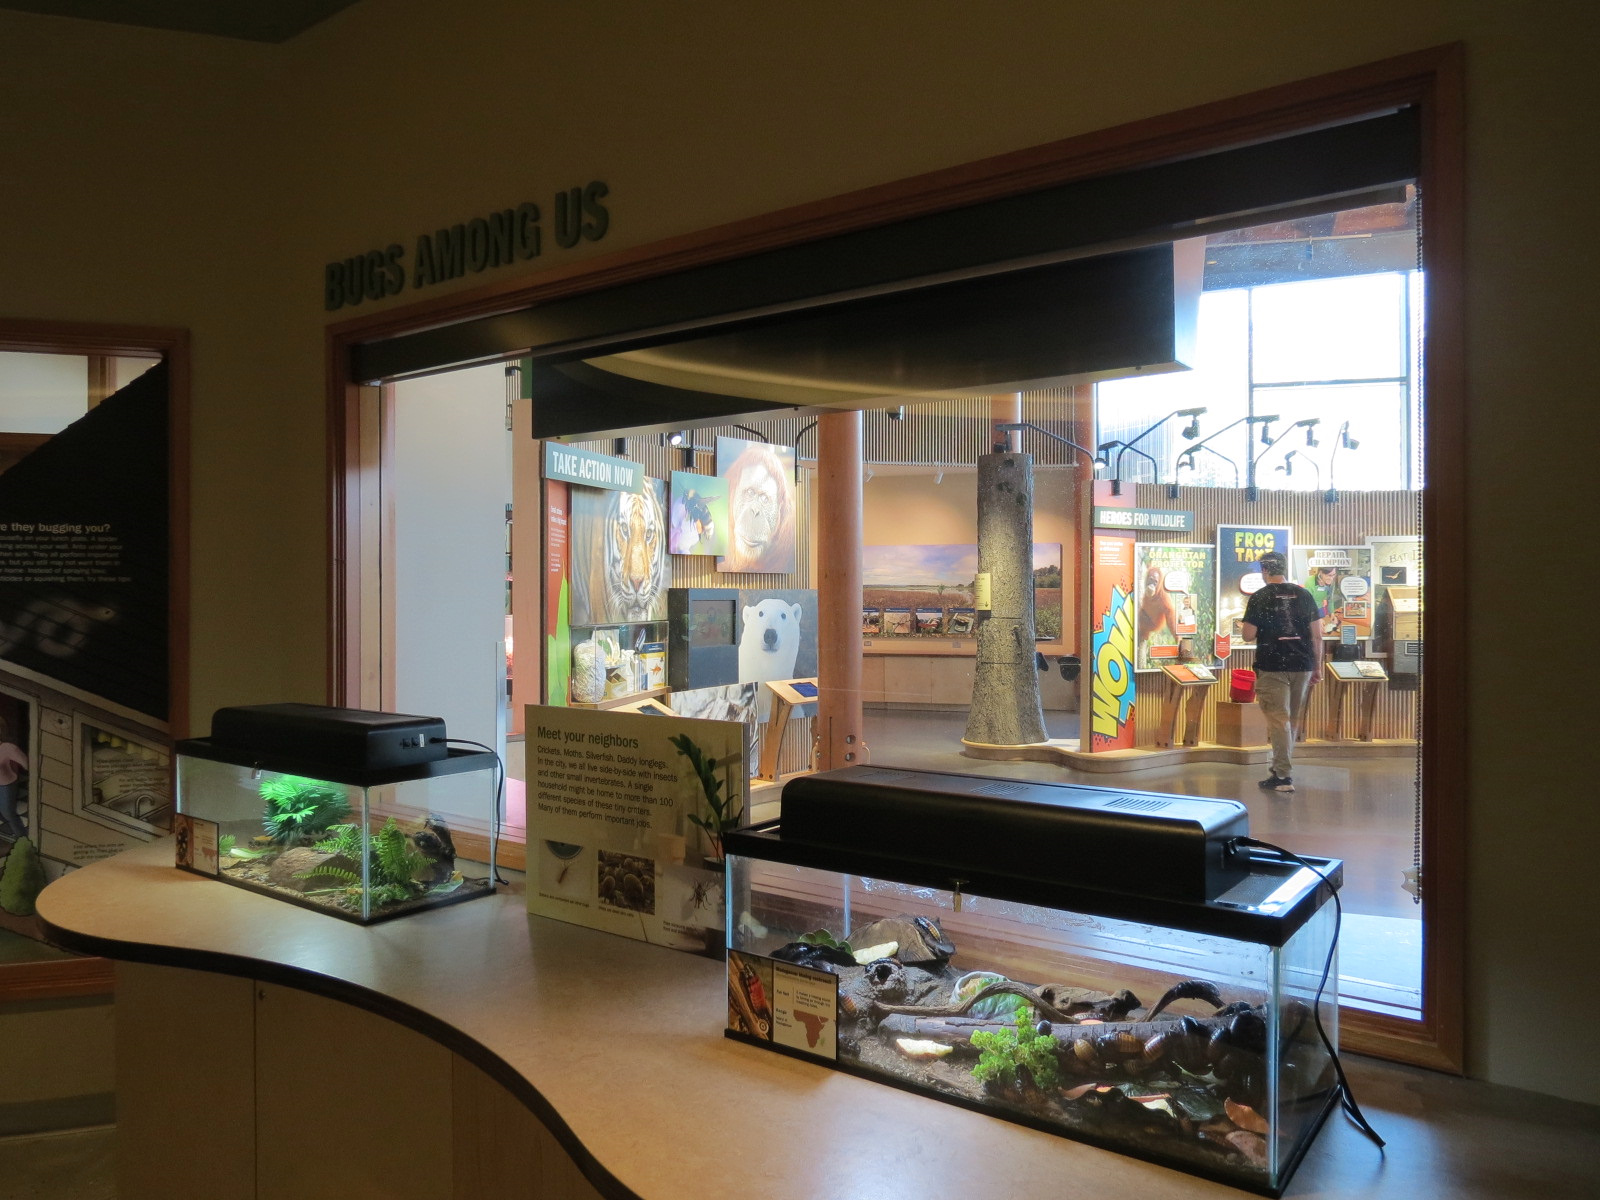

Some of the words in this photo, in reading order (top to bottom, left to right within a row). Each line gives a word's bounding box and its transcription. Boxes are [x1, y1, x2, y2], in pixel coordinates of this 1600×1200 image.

[325, 243, 404, 311] BUGS
[414, 202, 541, 289] AMONG
[555, 181, 609, 248] US
[552, 451, 578, 477] TAKE
[579, 457, 612, 484] ACTION
[614, 465, 634, 487] NOW
[1099, 510, 1132, 525] HEROES
[1133, 513, 1149, 526] FOR
[1150, 513, 1185, 528] WILDLIFE
[12, 522, 35, 534] they
[38, 522, 82, 535] bugging
[85, 523, 112, 535] you?
[1235, 532, 1275, 548] FROG
[1149, 551, 1206, 559] ORANGUTAN
[1151, 560, 1204, 568] PROTECTOR
[1235, 548, 1274, 563] TAX
[1310, 558, 1351, 566] CHAMPION
[1316, 551, 1345, 559] REPAIR
[537, 726, 561, 741] Meet
[564, 731, 585, 744] your
[589, 733, 639, 749] neighbors
[617, 754, 637, 766] Daddy
[537, 757, 544, 765] In
[544, 758, 554, 766] the
[588, 763, 598, 772] live
[599, 765, 637, 777] side-by-side
[638, 770, 651, 780] with
[654, 771, 678, 783] insects
[537, 769, 549, 777] and
[549, 771, 566, 779] other
[566, 773, 583, 782] small
[628, 780, 633, 788] A
[634, 783, 653, 793] single
[537, 780, 568, 791] household
[569, 784, 586, 795] might
[586, 786, 595, 795] be
[597, 788, 614, 798] home
[616, 791, 623, 799] to
[624, 794, 641, 802] more
[642, 795, 658, 804] than
[659, 797, 674, 807] 100
[537, 791, 562, 802] different
[563, 796, 586, 806] species
[587, 799, 595, 807] of
[595, 800, 613, 810] these
[614, 804, 626, 815] tiny
[537, 802, 554, 813] Many
[554, 805, 562, 813] of
[562, 807, 578, 817] them
[578, 810, 603, 821] perform
[604, 813, 635, 825] important
